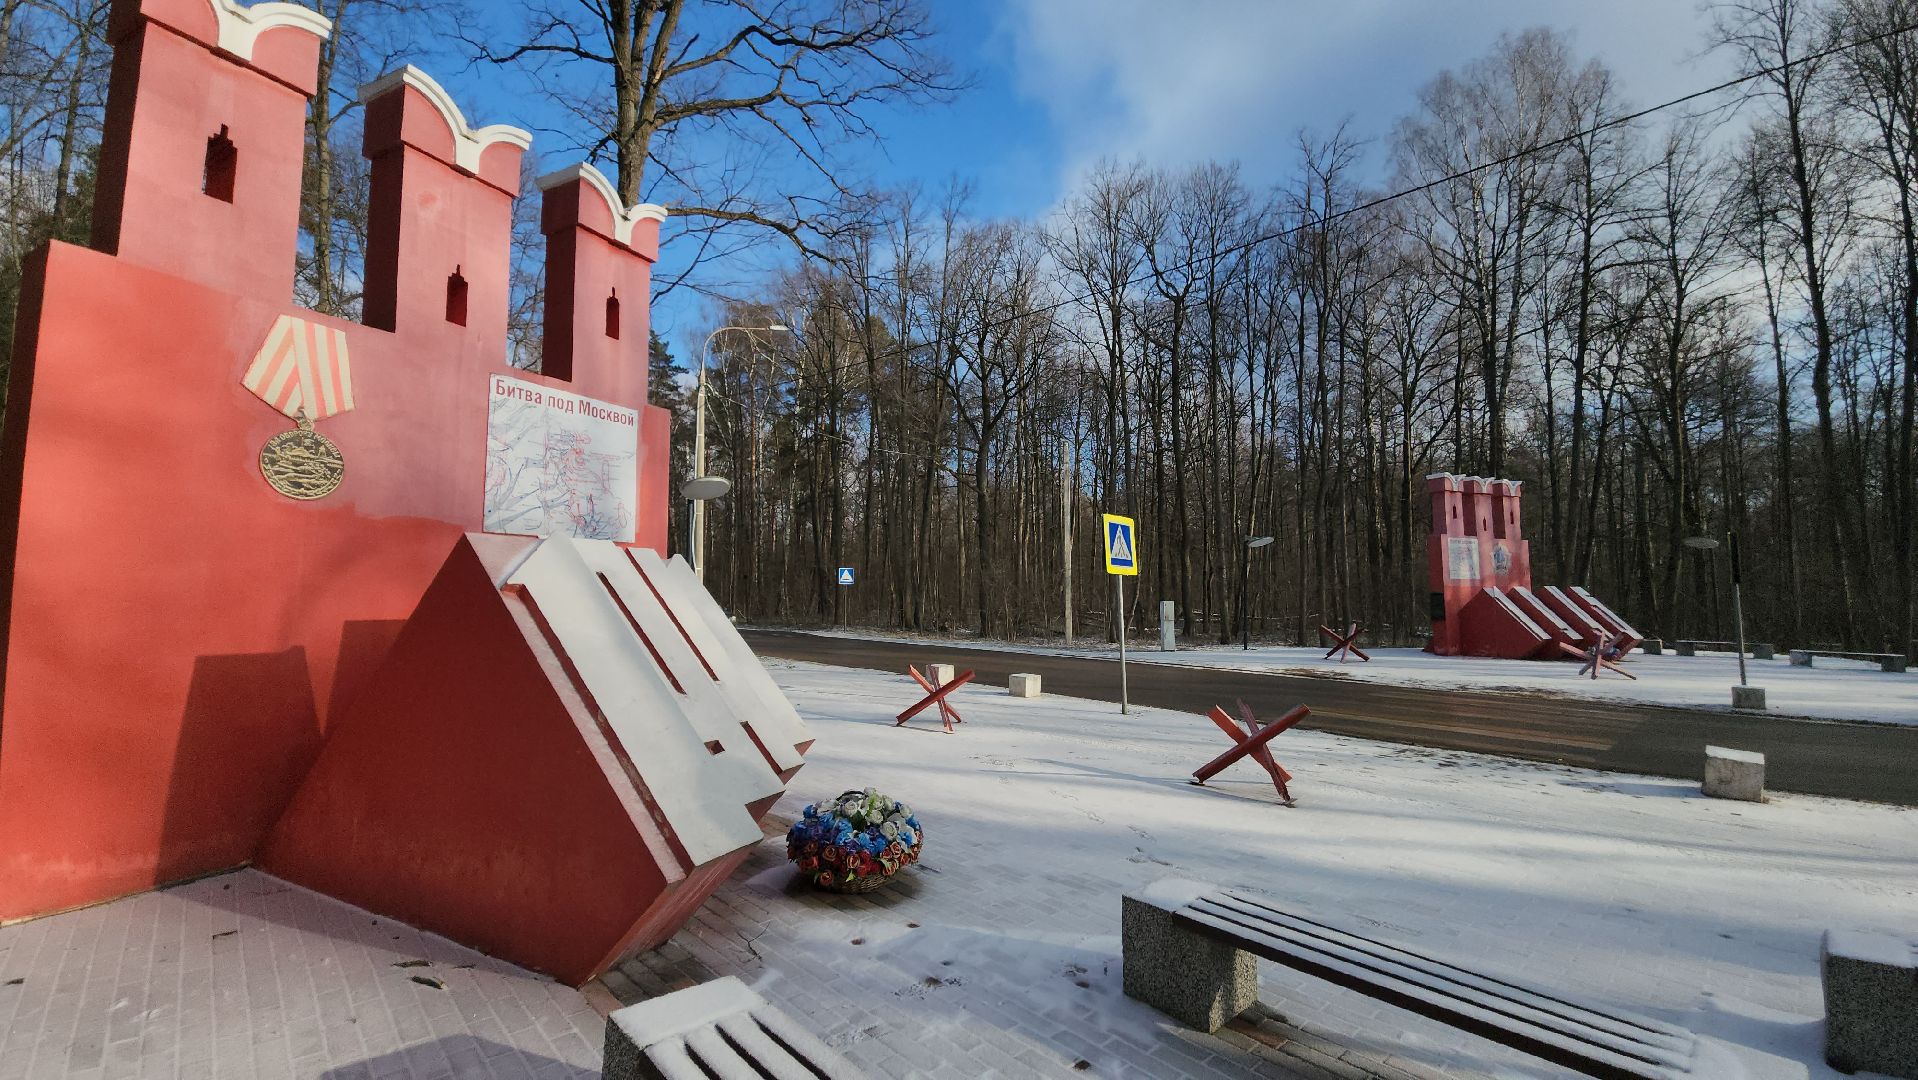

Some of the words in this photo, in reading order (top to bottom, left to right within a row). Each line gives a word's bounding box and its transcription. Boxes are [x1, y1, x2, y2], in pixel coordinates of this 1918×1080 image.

[495, 378, 542, 405] Битва
[547, 395, 574, 415] под
[578, 399, 634, 427] Москвой
